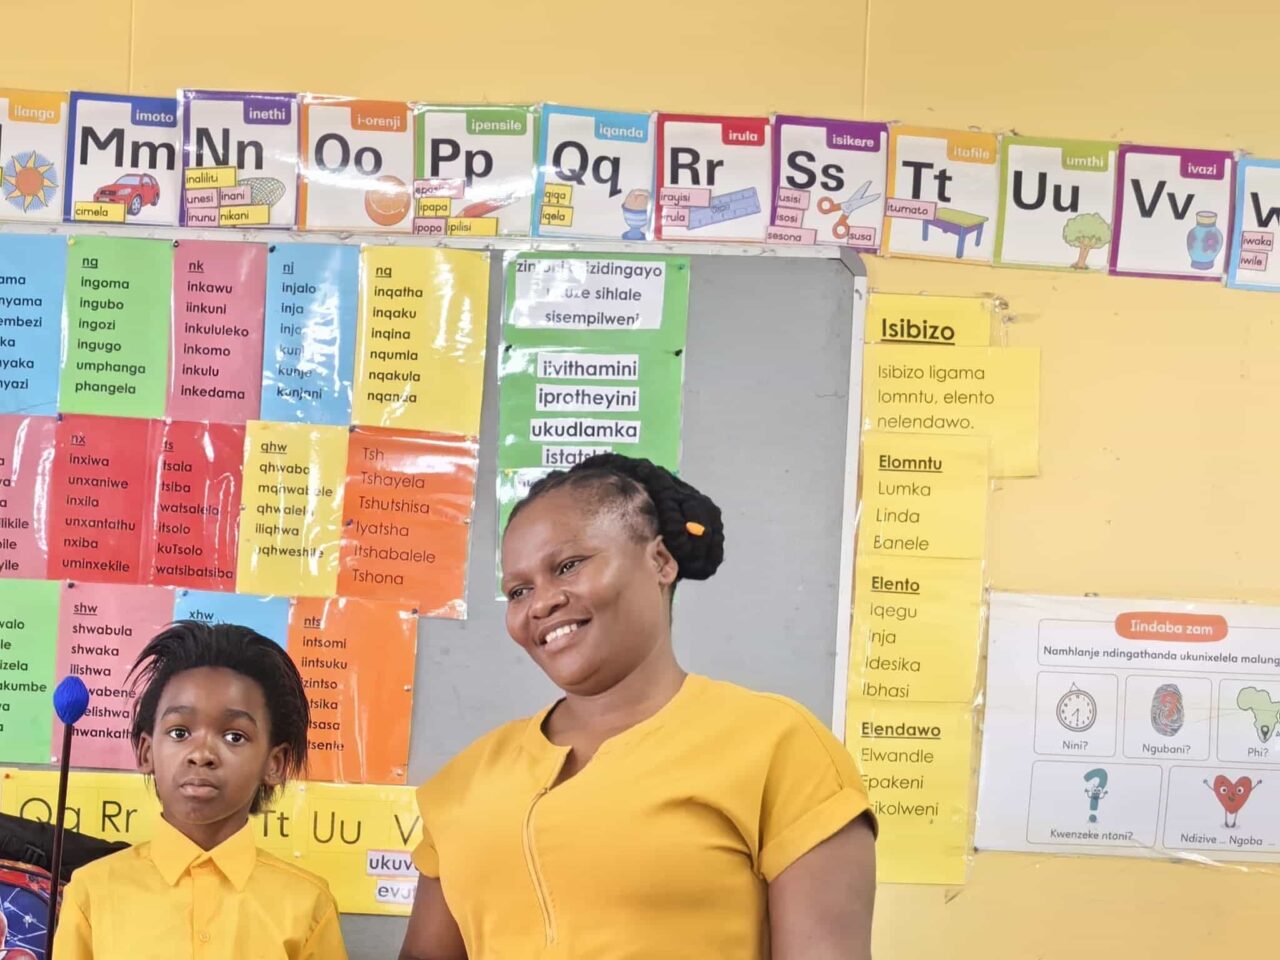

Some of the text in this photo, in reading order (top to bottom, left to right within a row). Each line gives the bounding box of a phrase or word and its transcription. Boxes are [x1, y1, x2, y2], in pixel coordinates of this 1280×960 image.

[14, 106, 55, 121] ilanga
[136, 111, 174, 123] imoto
[249, 108, 286, 120] inethi
[357, 114, 401, 128] i-orenji
[471, 119, 522, 134] ipensile
[599, 125, 644, 139] iqanda
[728, 130, 758, 142] irula
[80, 126, 176, 170] Mm
[832, 134, 875, 148] isikere
[195, 128, 264, 170] Nn
[314, 133, 383, 176] Oo
[954, 148, 990, 160] itafile
[430, 138, 494, 188] Pp
[670, 147, 724, 186] Rr
[1066, 156, 1104, 168] umthi
[1188, 163, 1217, 175] ivazi
[552, 141, 622, 198] Qq
[786, 151, 845, 192] Ss
[902, 161, 953, 203] Tt
[186, 193, 214, 204] unesi
[1013, 170, 1080, 213] Uu
[1131, 179, 1195, 220] Vv
[75, 207, 109, 217] cimela
[220, 210, 250, 221] nikani
[420, 203, 448, 214] ipapa
[887, 204, 929, 216] itumato
[189, 212, 216, 222] inunu
[415, 223, 442, 234] ipopo
[768, 232, 802, 242] sesona
[1243, 235, 1272, 246] iwaka
[188, 260, 204, 273] nk
[81, 276, 130, 290] ingoma
[187, 281, 233, 294] inkawu
[282, 283, 317, 296] injalo
[374, 286, 423, 300] inqatha
[595, 288, 642, 301] sihlale
[79, 298, 124, 311] ingubo
[372, 308, 417, 321] inqaku
[881, 318, 956, 345] Isibizo
[183, 344, 231, 357] inkomo
[878, 365, 986, 382] Isibizo ligama
[75, 381, 136, 395] phangela
[538, 389, 637, 409] iprotheyini
[878, 390, 995, 405] lomntu, elento
[531, 421, 638, 437] ukudlamka
[877, 415, 975, 430] nelendawo.
[260, 442, 288, 454] qhw
[69, 454, 110, 467] inxiwa
[878, 455, 943, 473] Elomntu
[360, 471, 426, 490] Tshayela
[878, 481, 932, 496] Lumka
[359, 496, 431, 515] Tshutshisa
[876, 509, 921, 523] Linda
[158, 523, 191, 536] itsolo
[64, 537, 99, 549] nxiba
[352, 569, 404, 585] Tshona
[871, 576, 921, 594] Elento
[72, 624, 133, 636] shwabula
[1130, 619, 1213, 635] Iindaba zam
[302, 636, 347, 649] intsomi
[71, 645, 119, 656] shwaka
[1043, 646, 1238, 663] Namhlanje ndingathanda ukunixelela
[301, 658, 348, 670] iintsuku
[862, 682, 910, 698] Ibhasi
[861, 722, 941, 739] Elendawo
[1062, 740, 1088, 751] Nini?
[1142, 743, 1191, 755] Ngubani?
[1247, 747, 1269, 758] Phi?
[860, 749, 934, 763] Elwandle
[100, 800, 138, 833] Rr
[312, 811, 363, 845] Uu
[1050, 829, 1099, 840] Kwenzeke
[1180, 833, 1263, 846] Ndizive Ngoba
